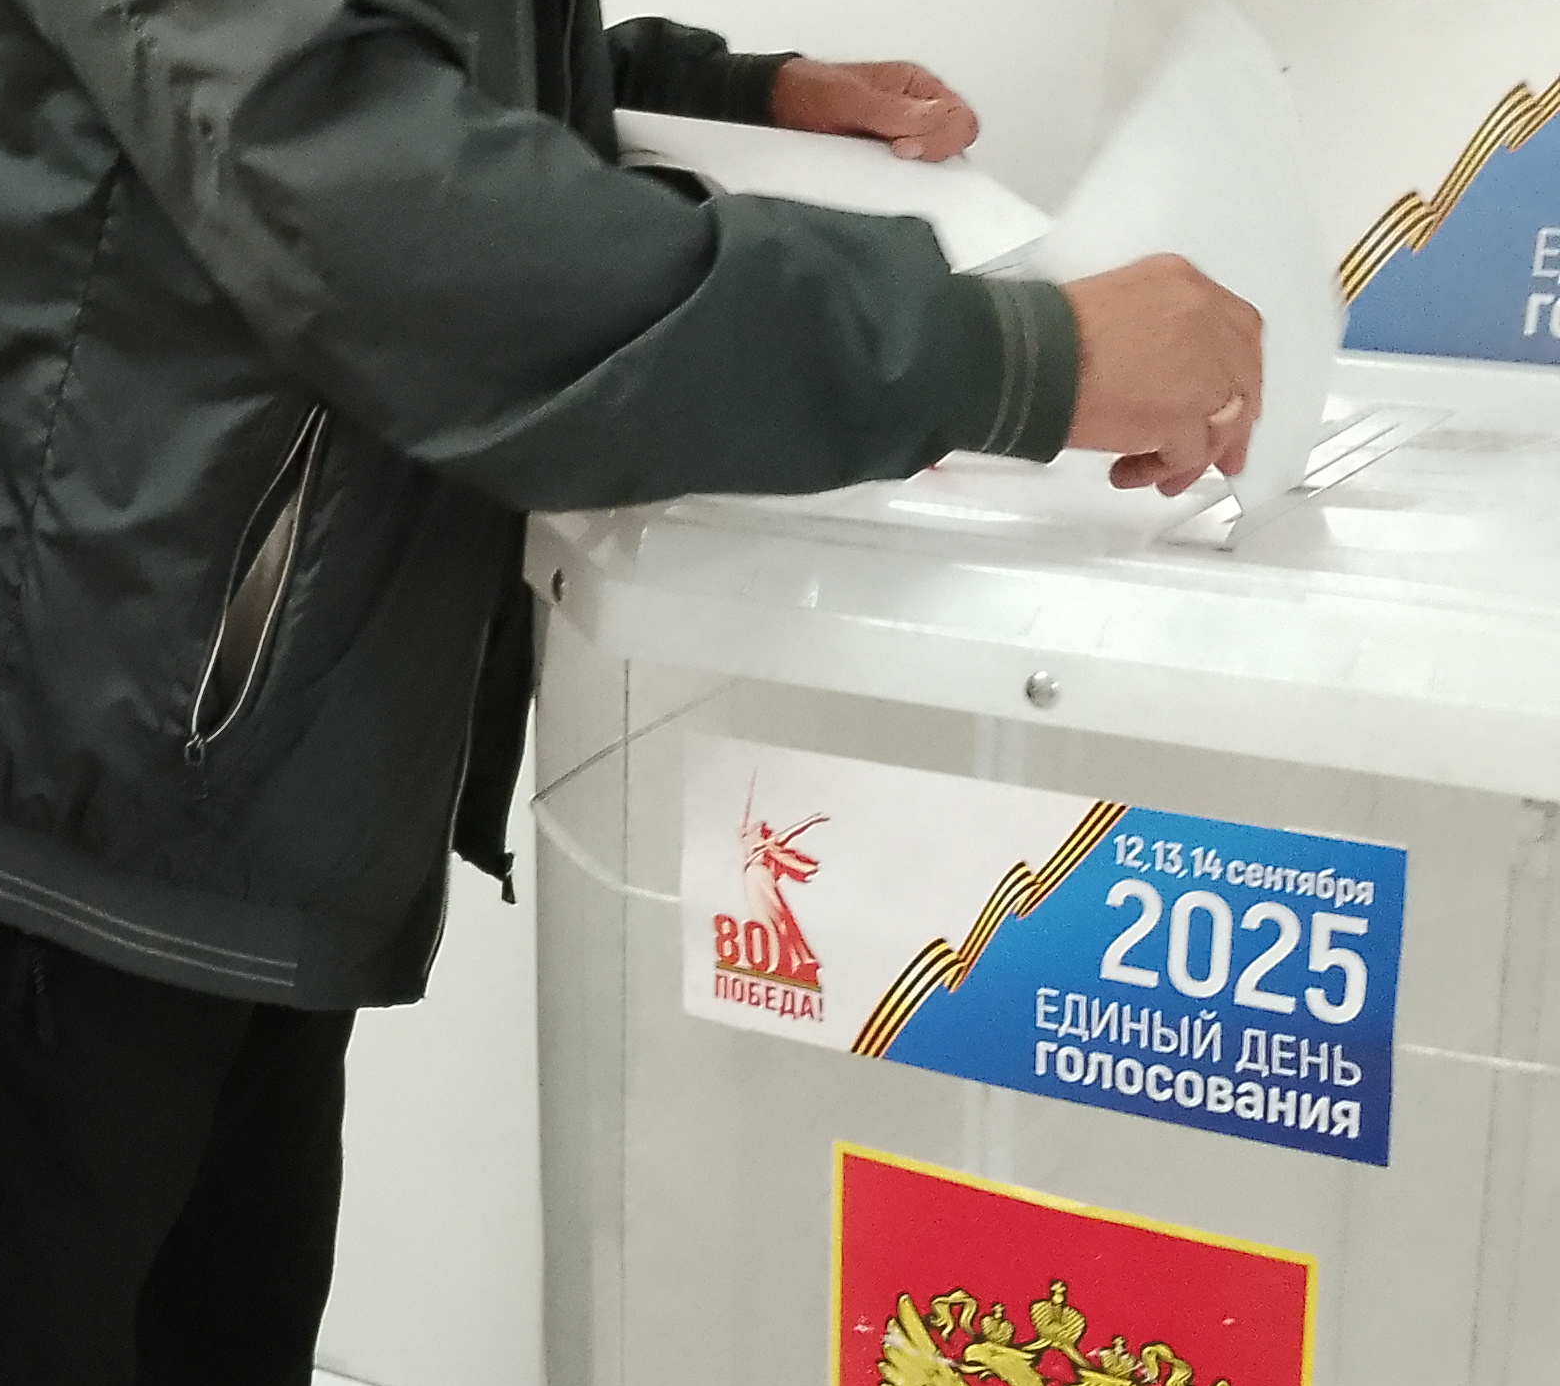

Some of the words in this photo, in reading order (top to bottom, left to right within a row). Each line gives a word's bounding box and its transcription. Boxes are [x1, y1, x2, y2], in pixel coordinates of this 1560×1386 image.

[1225, 859, 1375, 908] сентября
[713, 913, 771, 973] 80
[1099, 878, 1370, 1025] 2025
[714, 973, 824, 1022] ПОБЕДА!
[1035, 987, 1223, 1063] ЕДИНЫЙ
[1235, 1027, 1363, 1087] ДЕНЬ
